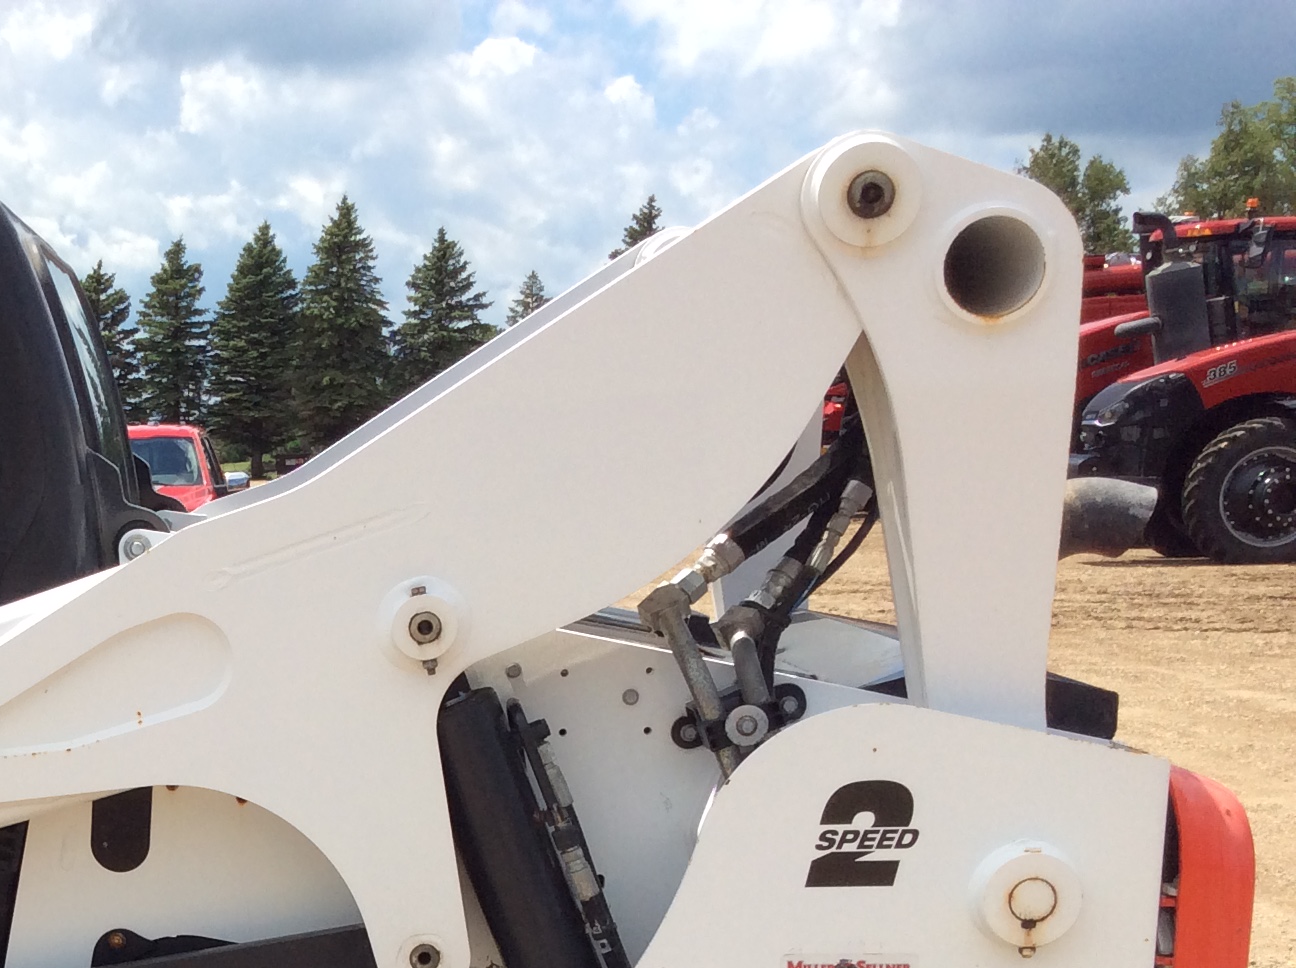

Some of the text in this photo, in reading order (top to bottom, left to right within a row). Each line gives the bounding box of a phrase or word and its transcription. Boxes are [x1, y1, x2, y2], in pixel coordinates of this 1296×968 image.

[1206, 360, 1238, 381] 385
[804, 779, 914, 888] 2
[814, 828, 920, 851] SPEED
